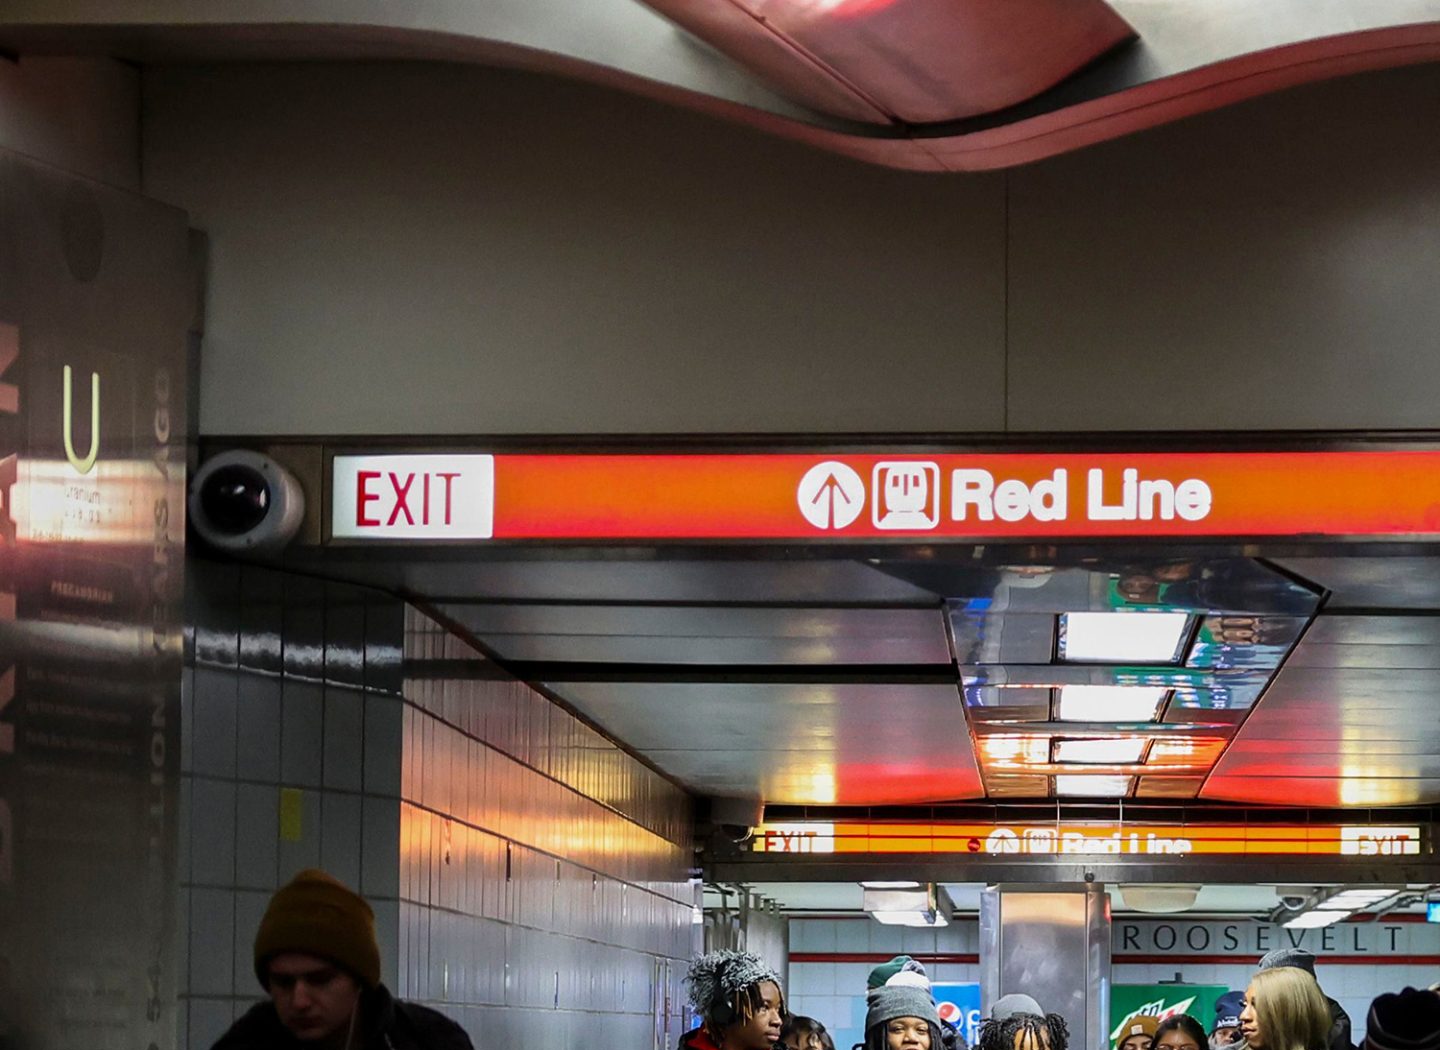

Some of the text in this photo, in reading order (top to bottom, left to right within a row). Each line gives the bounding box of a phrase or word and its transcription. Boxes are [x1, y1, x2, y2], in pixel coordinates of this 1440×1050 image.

[63, 364, 99, 474] U
[357, 470, 462, 526] EXIT
[951, 467, 1067, 522] Red
[1087, 467, 1212, 521] Line
[764, 830, 818, 852] EXIT
[1062, 832, 1120, 854] Red
[1358, 834, 1409, 855] EXIT
[1122, 924, 1403, 952] ROOSEVELT
